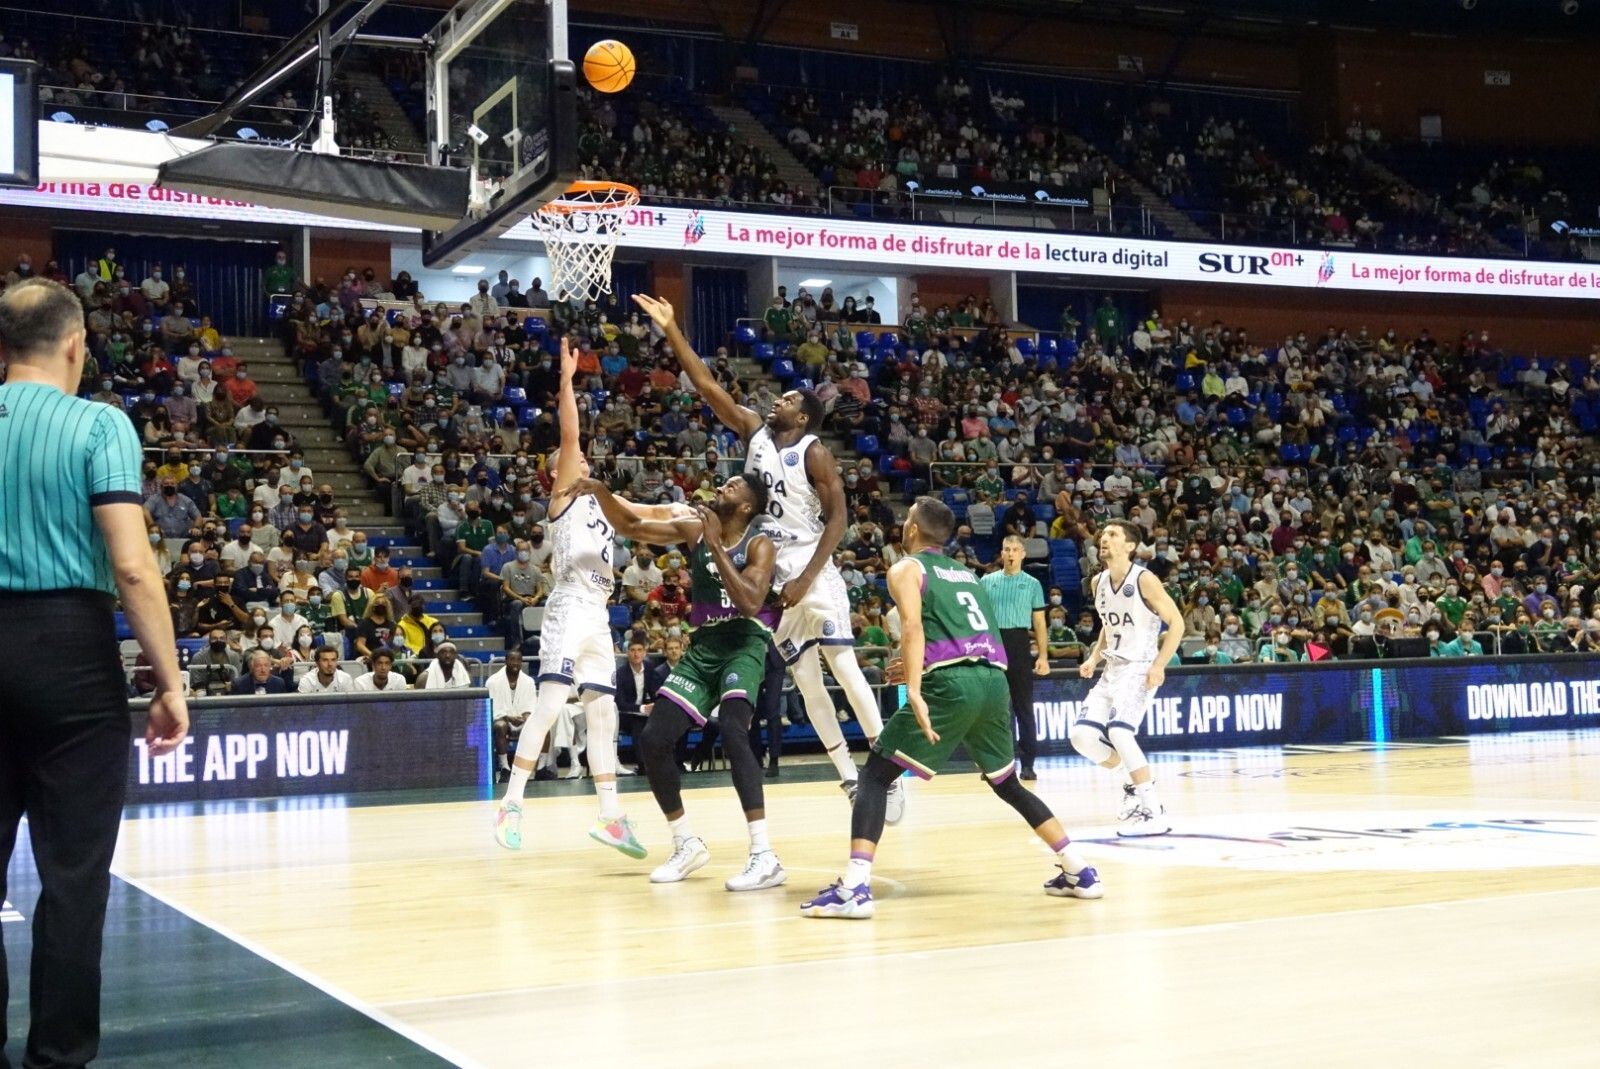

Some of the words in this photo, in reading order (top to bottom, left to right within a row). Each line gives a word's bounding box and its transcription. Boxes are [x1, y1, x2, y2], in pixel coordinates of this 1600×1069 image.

[727, 223, 750, 243] La
[756, 227, 814, 249] mejor
[819, 229, 877, 250] forma
[883, 234, 906, 252] de
[911, 236, 993, 258] disfrutar
[998, 241, 1020, 260] de
[1025, 242, 1041, 260] la
[1046, 243, 1107, 264] lectura
[1112, 247, 1168, 270] digital
[1198, 252, 1272, 276] SUR
[1352, 263, 1370, 279] La
[1375, 265, 1421, 284] mejor
[1425, 266, 1471, 283] forma
[1476, 268, 1494, 283] de
[1500, 269, 1564, 287] disfrutar
[1569, 272, 1587, 288] de
[720, 588, 736, 609] 5
[956, 591, 989, 631] 3
[1113, 633, 1122, 650] 7
[1149, 698, 1183, 735] THE
[1188, 696, 1230, 733] APP
[1235, 693, 1283, 732] NOW
[1467, 681, 1567, 720] DOWNLOAD
[1570, 680, 1600, 715] THE
[134, 737, 194, 785] THE
[203, 733, 268, 781] APP
[276, 729, 349, 778] NOW
